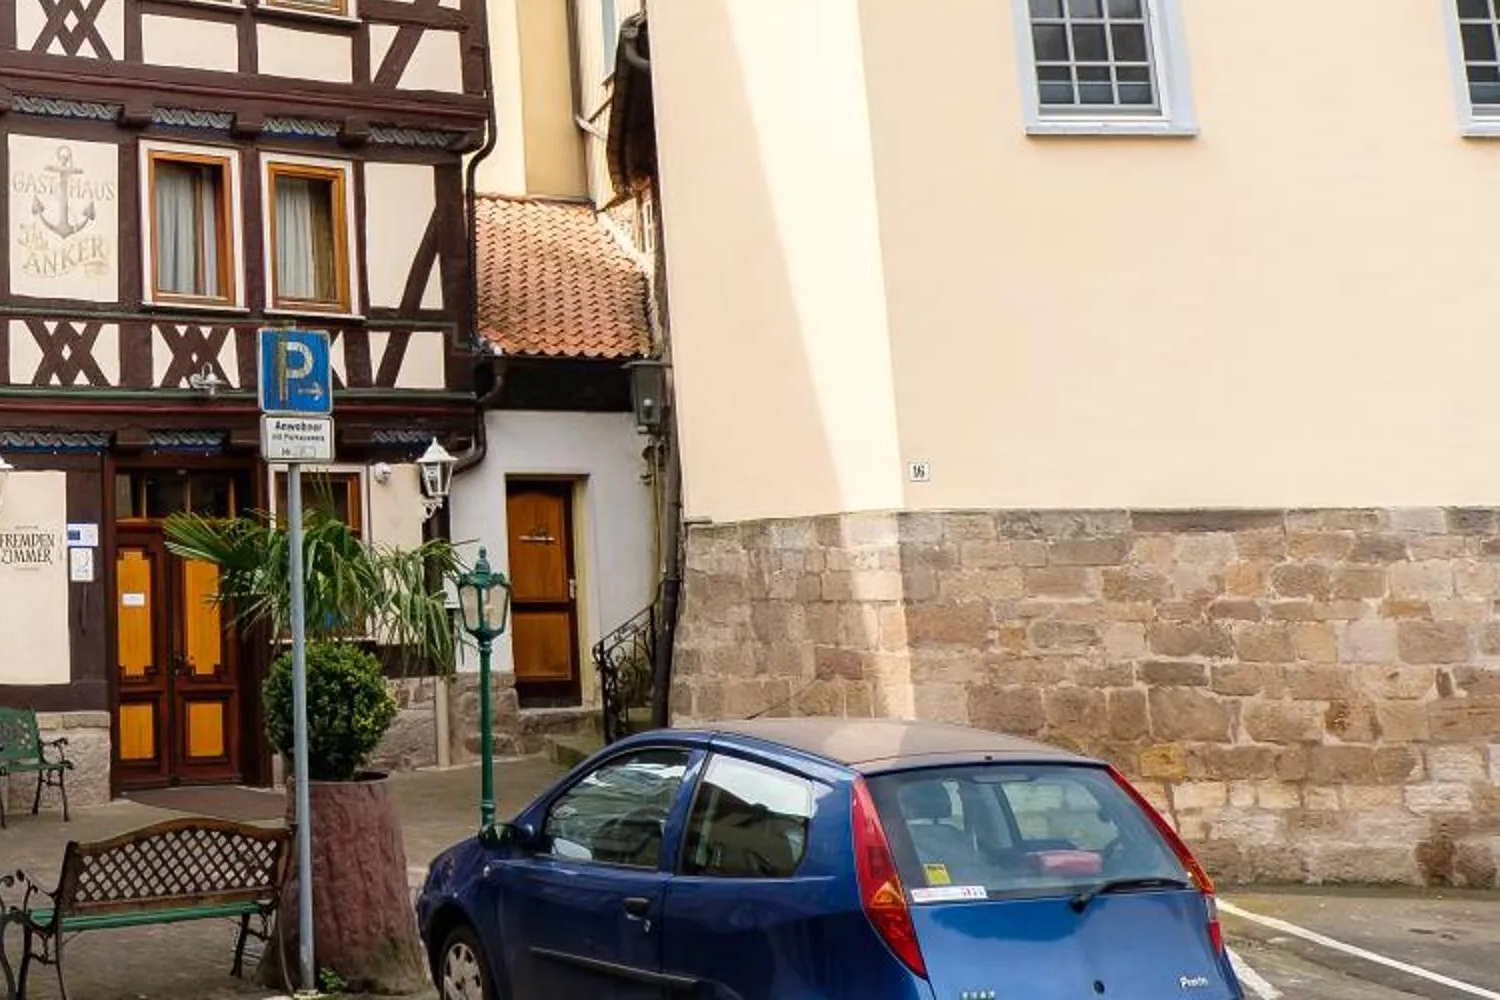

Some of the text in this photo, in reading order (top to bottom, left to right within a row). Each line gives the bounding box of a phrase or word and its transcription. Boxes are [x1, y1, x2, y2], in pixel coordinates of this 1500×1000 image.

[22, 235, 106, 275] ANKER
[279, 341, 314, 402] P
[913, 465, 925, 479] 16
[0, 549, 53, 565] ZIMMER
